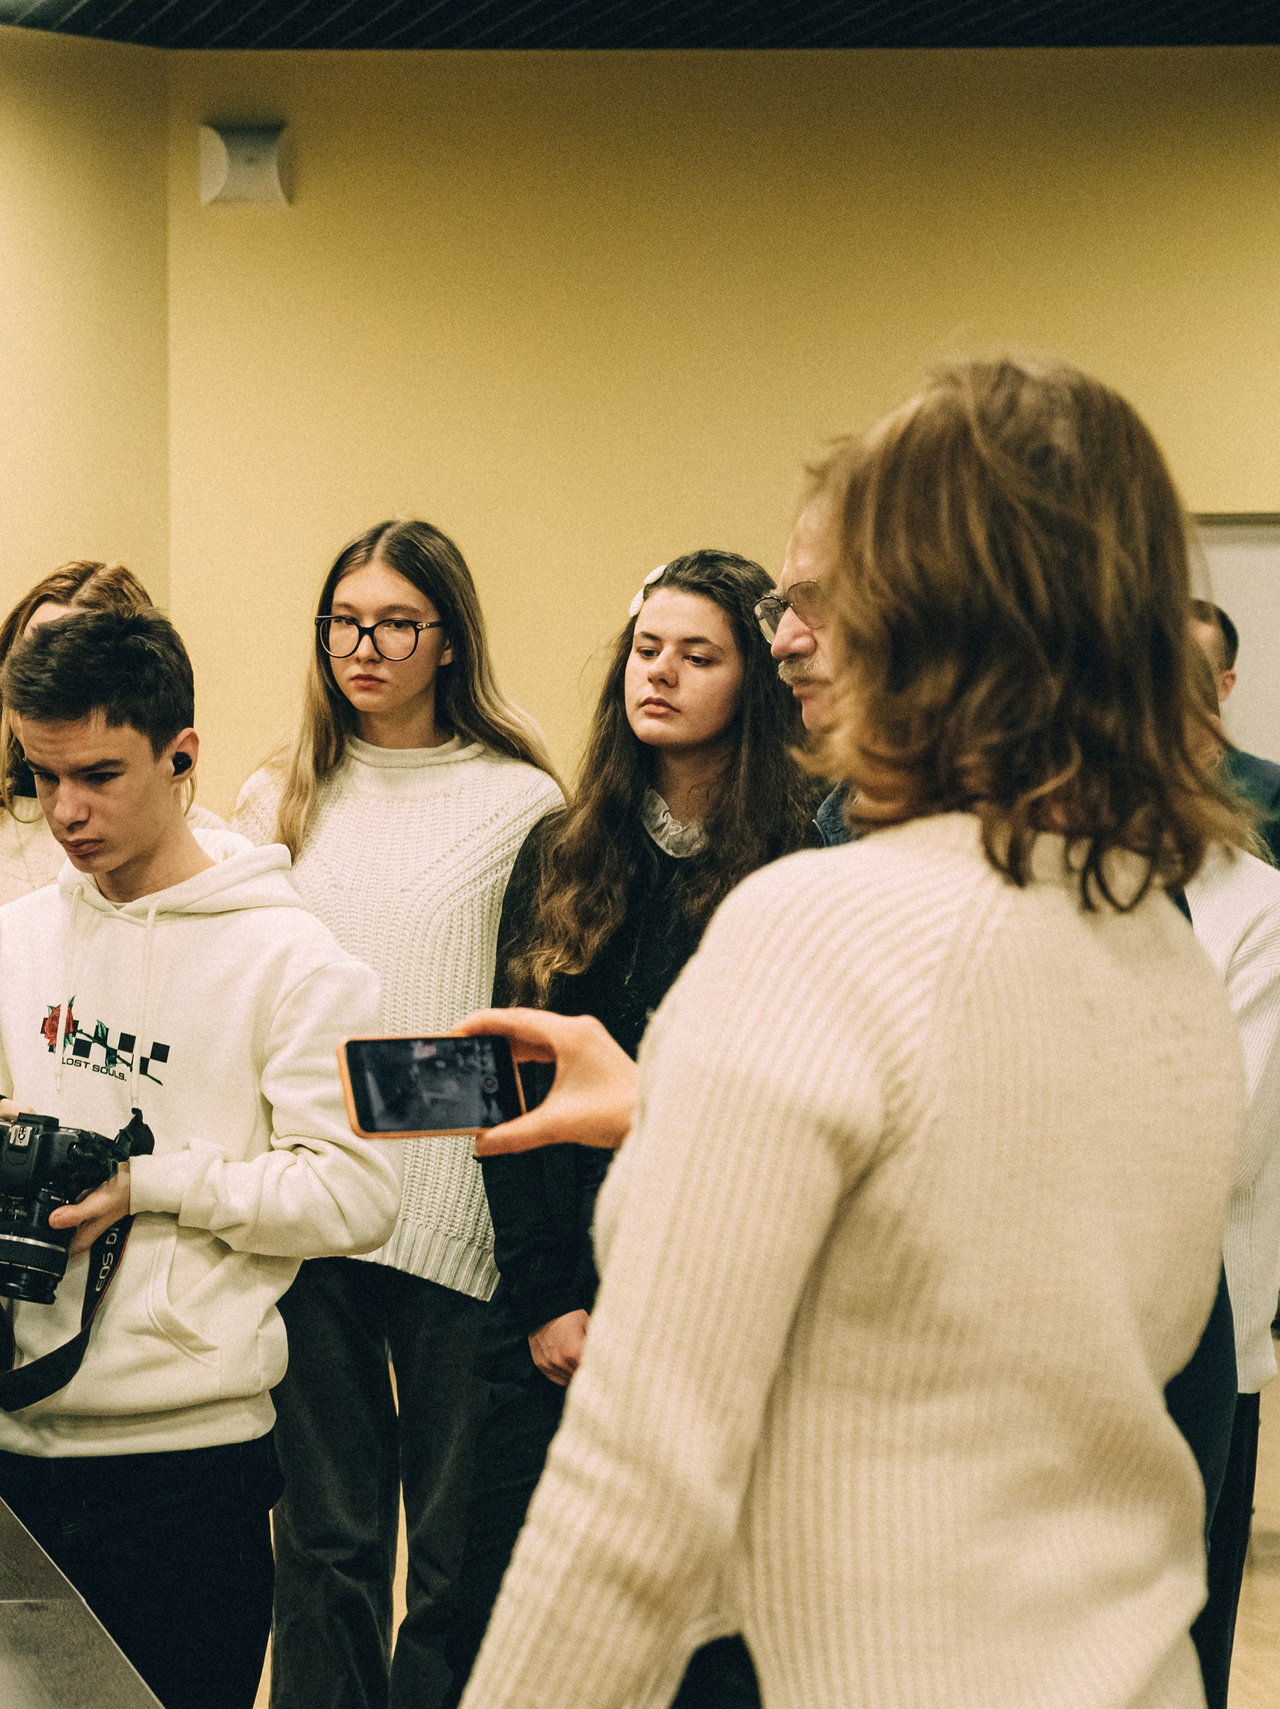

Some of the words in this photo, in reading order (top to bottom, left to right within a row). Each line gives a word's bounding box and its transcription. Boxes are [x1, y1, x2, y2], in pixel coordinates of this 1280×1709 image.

[61, 1057, 90, 1069] LOST
[91, 1064, 127, 1081] SOULS.
[95, 1252, 114, 1292] EOS
